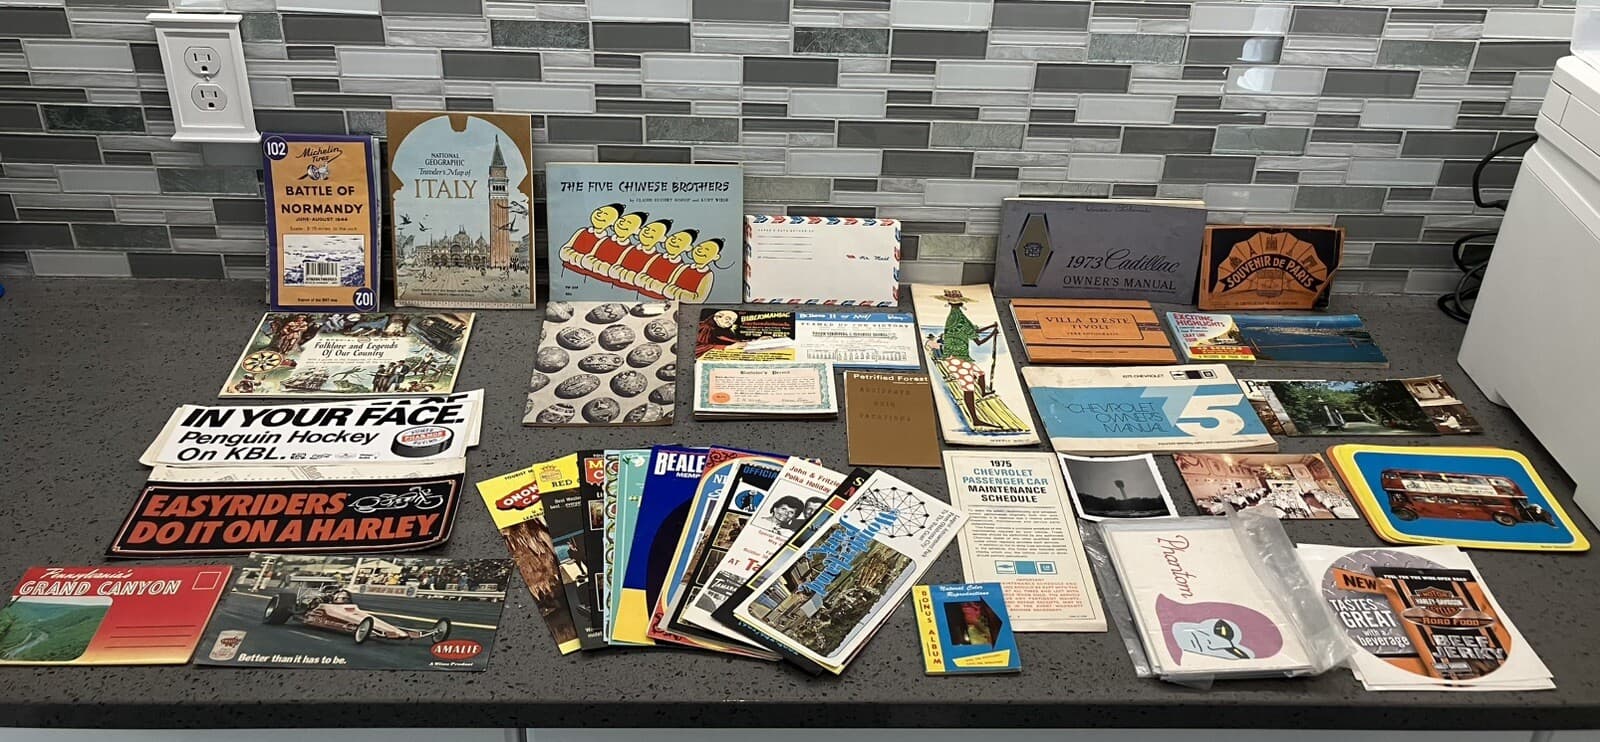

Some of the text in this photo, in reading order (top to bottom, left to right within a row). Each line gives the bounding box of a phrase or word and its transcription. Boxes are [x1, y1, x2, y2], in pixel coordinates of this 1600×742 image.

[267, 142, 286, 156] 102
[296, 145, 343, 160] Michelin
[312, 155, 330, 163] Tires
[446, 168, 465, 176] Map
[464, 169, 472, 177] of
[285, 186, 356, 196] BATTLE OF
[414, 178, 478, 199] ITALY
[560, 181, 730, 193] THE FIVE CHINESE BROTHERS
[281, 204, 363, 214] NORMANDY
[1065, 247, 1181, 273] 1973 Cadillac
[1226, 255, 1314, 288] SOUVENIR DE PARIS
[1063, 275, 1177, 290] OWNER'S MANUAL
[356, 292, 374, 306] 102
[1045, 316, 1082, 324] VILLA
[1172, 313, 1213, 322] EXCITING
[1175, 320, 1226, 328] HIGHLIGHTS
[367, 342, 398, 350] Legends
[321, 349, 332, 357] Of
[353, 349, 384, 358] Country
[853, 373, 895, 381] Petrified
[1065, 402, 1154, 413] CHEVROLET
[180, 404, 465, 427] IN YOUR FACE.
[1101, 423, 1169, 433] MANUAL
[178, 429, 380, 446] Penguin Hockey
[178, 447, 219, 461] On
[223, 446, 285, 461] KBL.
[654, 451, 706, 476] BEALE
[990, 459, 1012, 468] 1975
[504, 471, 526, 480] TOURIST
[789, 466, 807, 476] John
[973, 468, 1033, 477] CHEVROLET
[551, 479, 573, 488] RED
[784, 472, 832, 494] Polka Holiday
[962, 476, 1049, 486] PASSENGER CAR
[968, 485, 1047, 494] MAINTENANCE
[522, 494, 540, 505] CA
[981, 494, 1038, 503] SCHEDULE
[141, 492, 346, 518] EASYRIDERS
[126, 520, 307, 544] DO IT ON A
[920, 511, 955, 548] From Oklahoma City
[805, 512, 860, 561] Park
[798, 508, 900, 598] Wonderland
[921, 549, 932, 558] Park
[727, 558, 740, 566] AT
[1156, 534, 1197, 599] Phantom
[41, 567, 135, 582] Pennsylvania's
[19, 579, 184, 596] GRAND CANYON
[1342, 573, 1378, 591] NEW
[921, 590, 933, 624] BONUS
[1329, 598, 1378, 612] TASTES
[1415, 598, 1464, 606] HARLEY-DAVIDSON
[1340, 610, 1398, 630] GREAT
[1422, 617, 1479, 626] ROAD FOOD
[1363, 629, 1381, 637] with
[1357, 634, 1411, 648] beverage
[1432, 634, 1488, 647] BEEF
[434, 644, 479, 654] AMALIE
[928, 629, 942, 665] ALBUM
[1432, 646, 1505, 660] JERKY
[237, 653, 347, 665] Better than it has to be.
